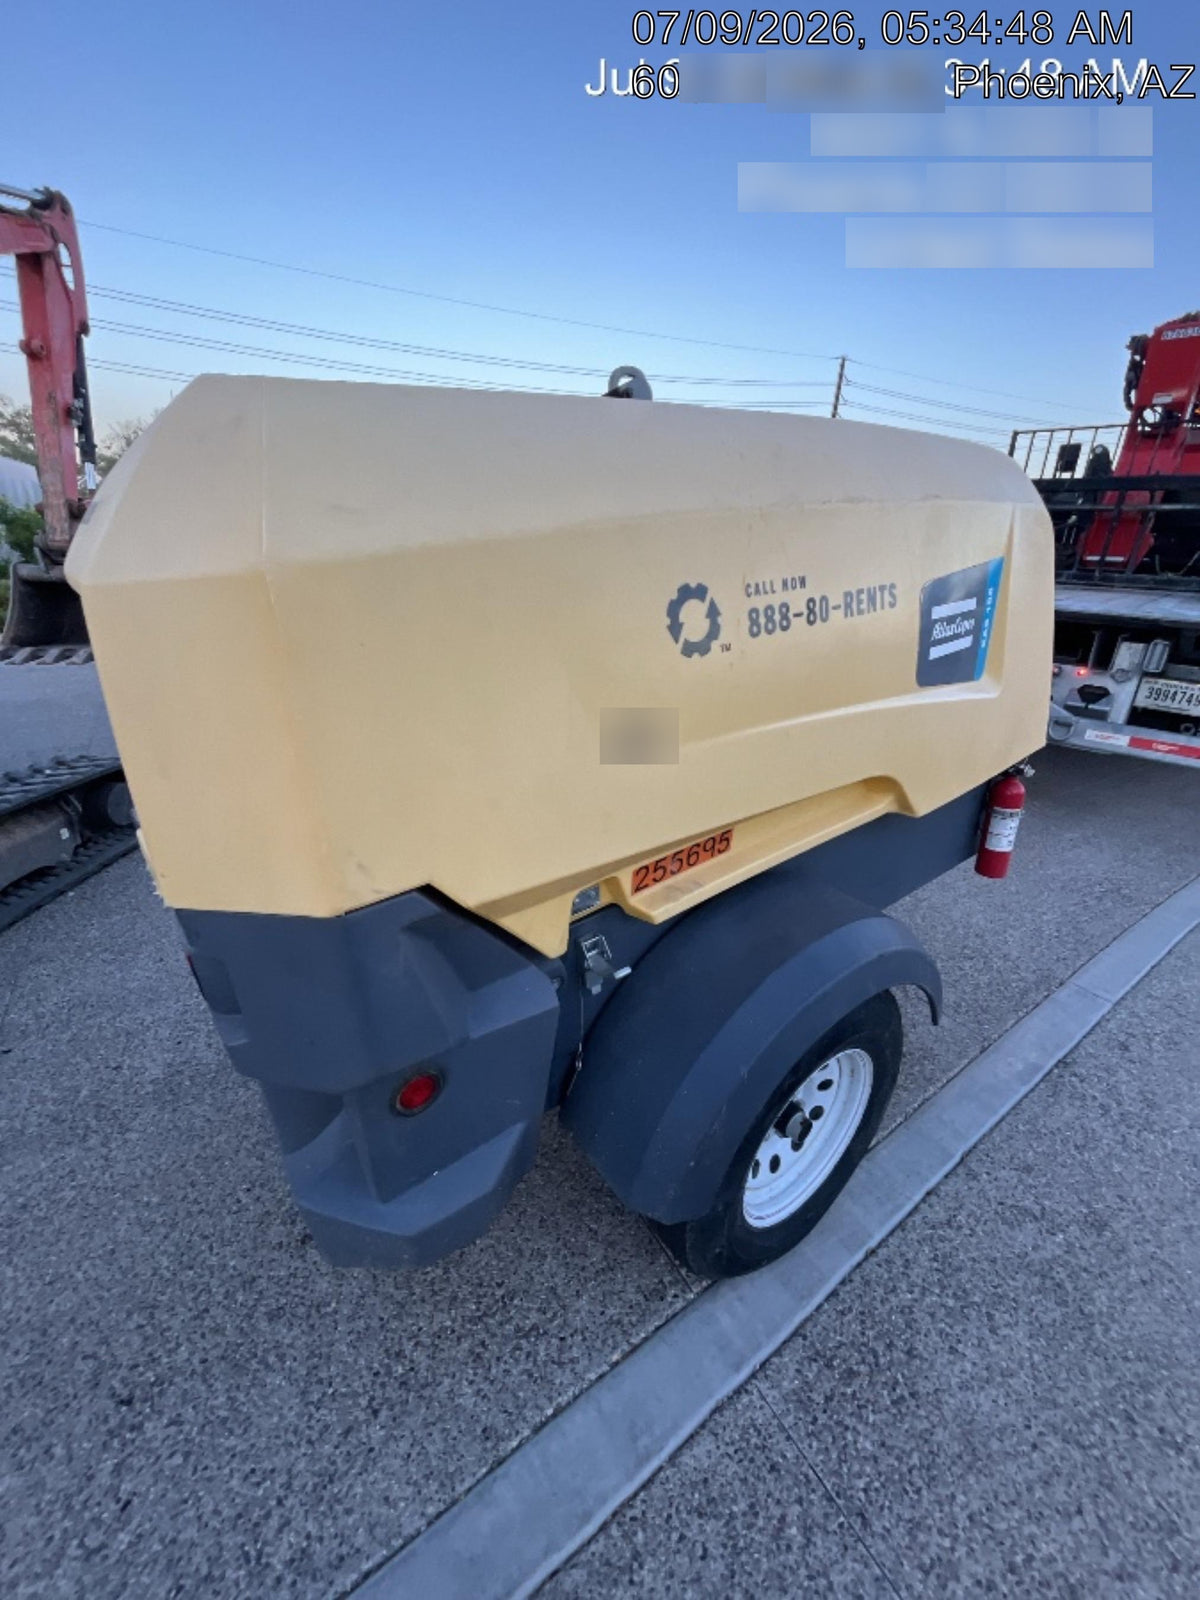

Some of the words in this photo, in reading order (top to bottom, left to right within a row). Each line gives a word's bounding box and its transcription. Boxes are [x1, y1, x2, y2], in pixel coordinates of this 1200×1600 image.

[745, 579, 776, 598] CALL
[782, 575, 807, 592] NOW
[748, 582, 897, 638] 888-80-RENTS
[632, 829, 732, 894] 255695
